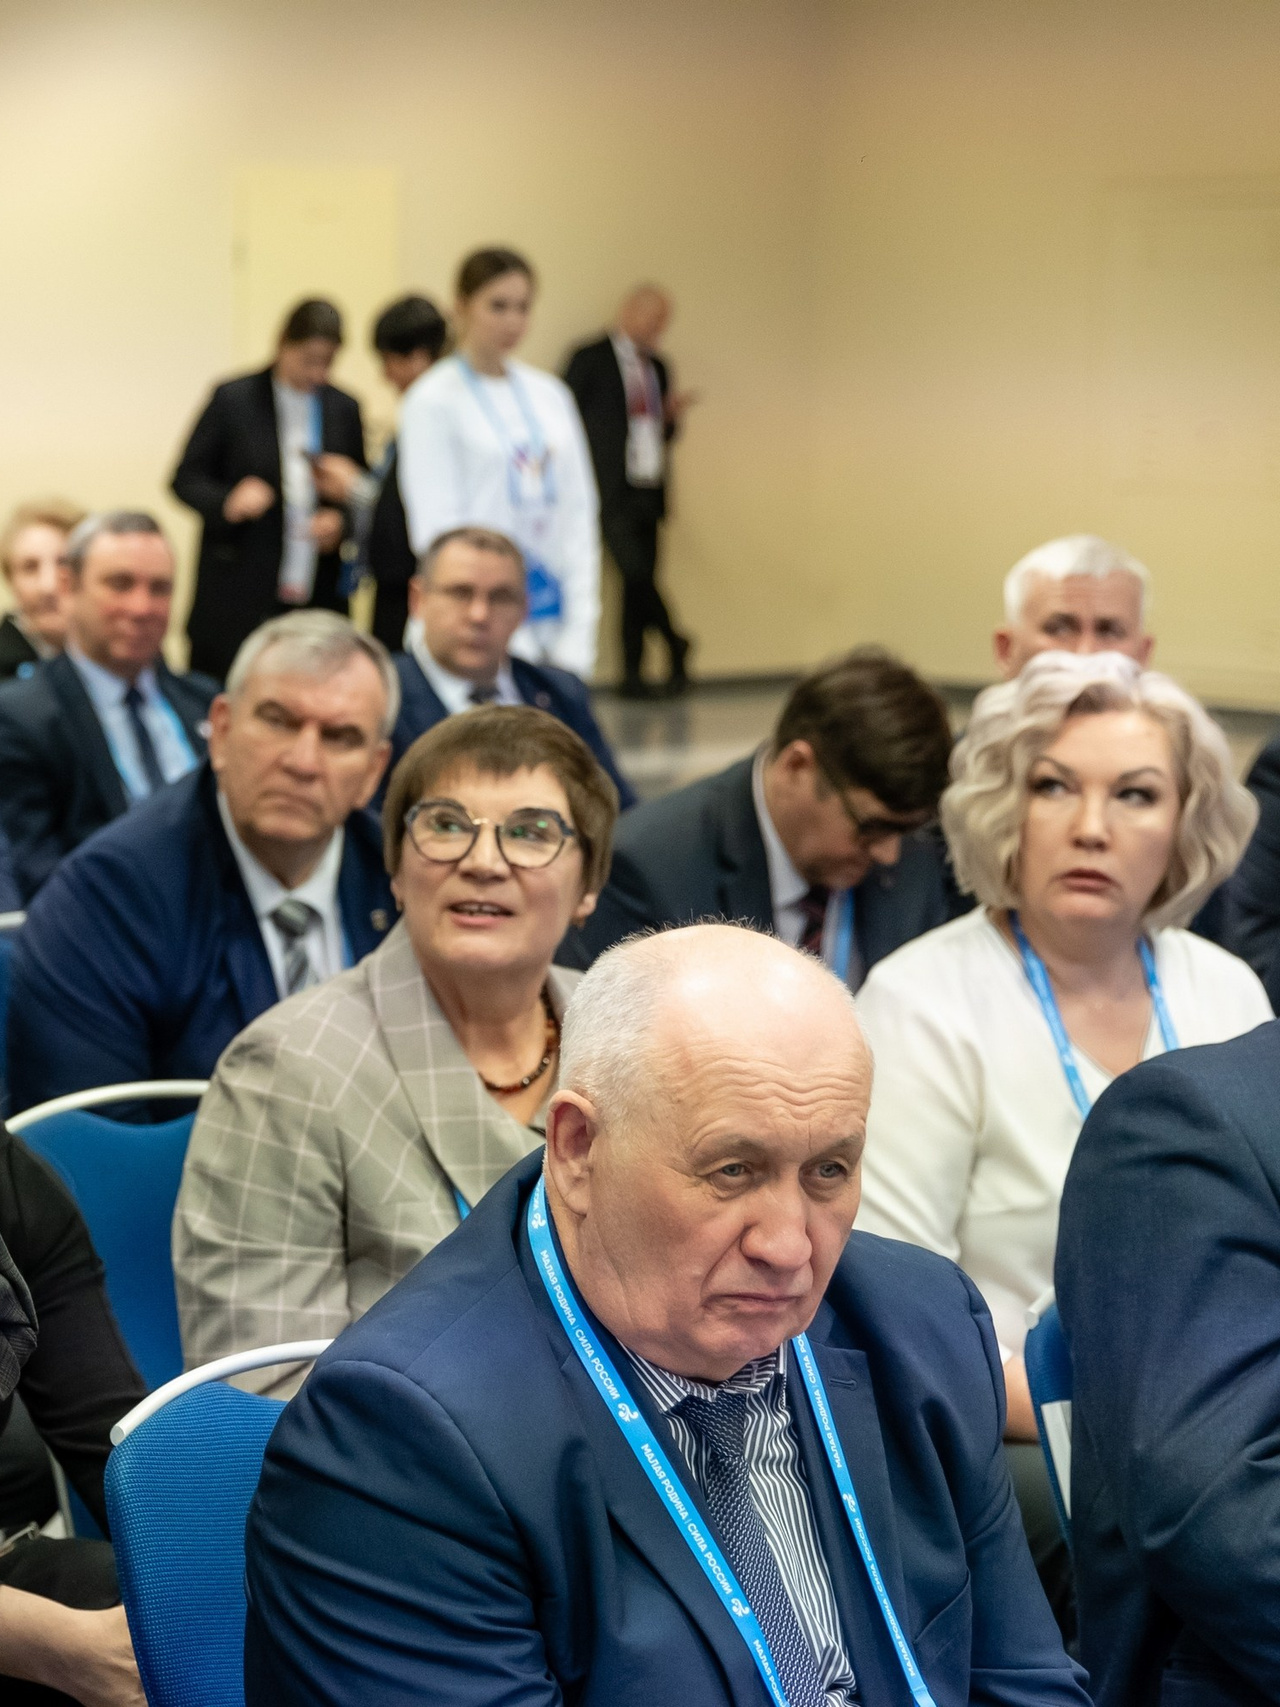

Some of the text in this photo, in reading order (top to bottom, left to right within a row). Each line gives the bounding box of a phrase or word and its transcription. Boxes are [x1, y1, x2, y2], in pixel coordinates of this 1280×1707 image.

[539, 1249, 621, 1400] МАЛАЯ РОДИНА СИЛА РОССИИ
[802, 1354, 817, 1385] СИЛА
[813, 1387, 831, 1431] РОДИНА
[825, 1431, 843, 1469] МАЛАЯ
[640, 1442, 733, 1595] МАЛАЯ РОДИНА СИЛА РОССИИ
[854, 1517, 917, 1678] МАЛАЯ РОДИНА СИЛА РОССИИ
[752, 1639, 786, 1707] МАЛАЯ РОДИ
